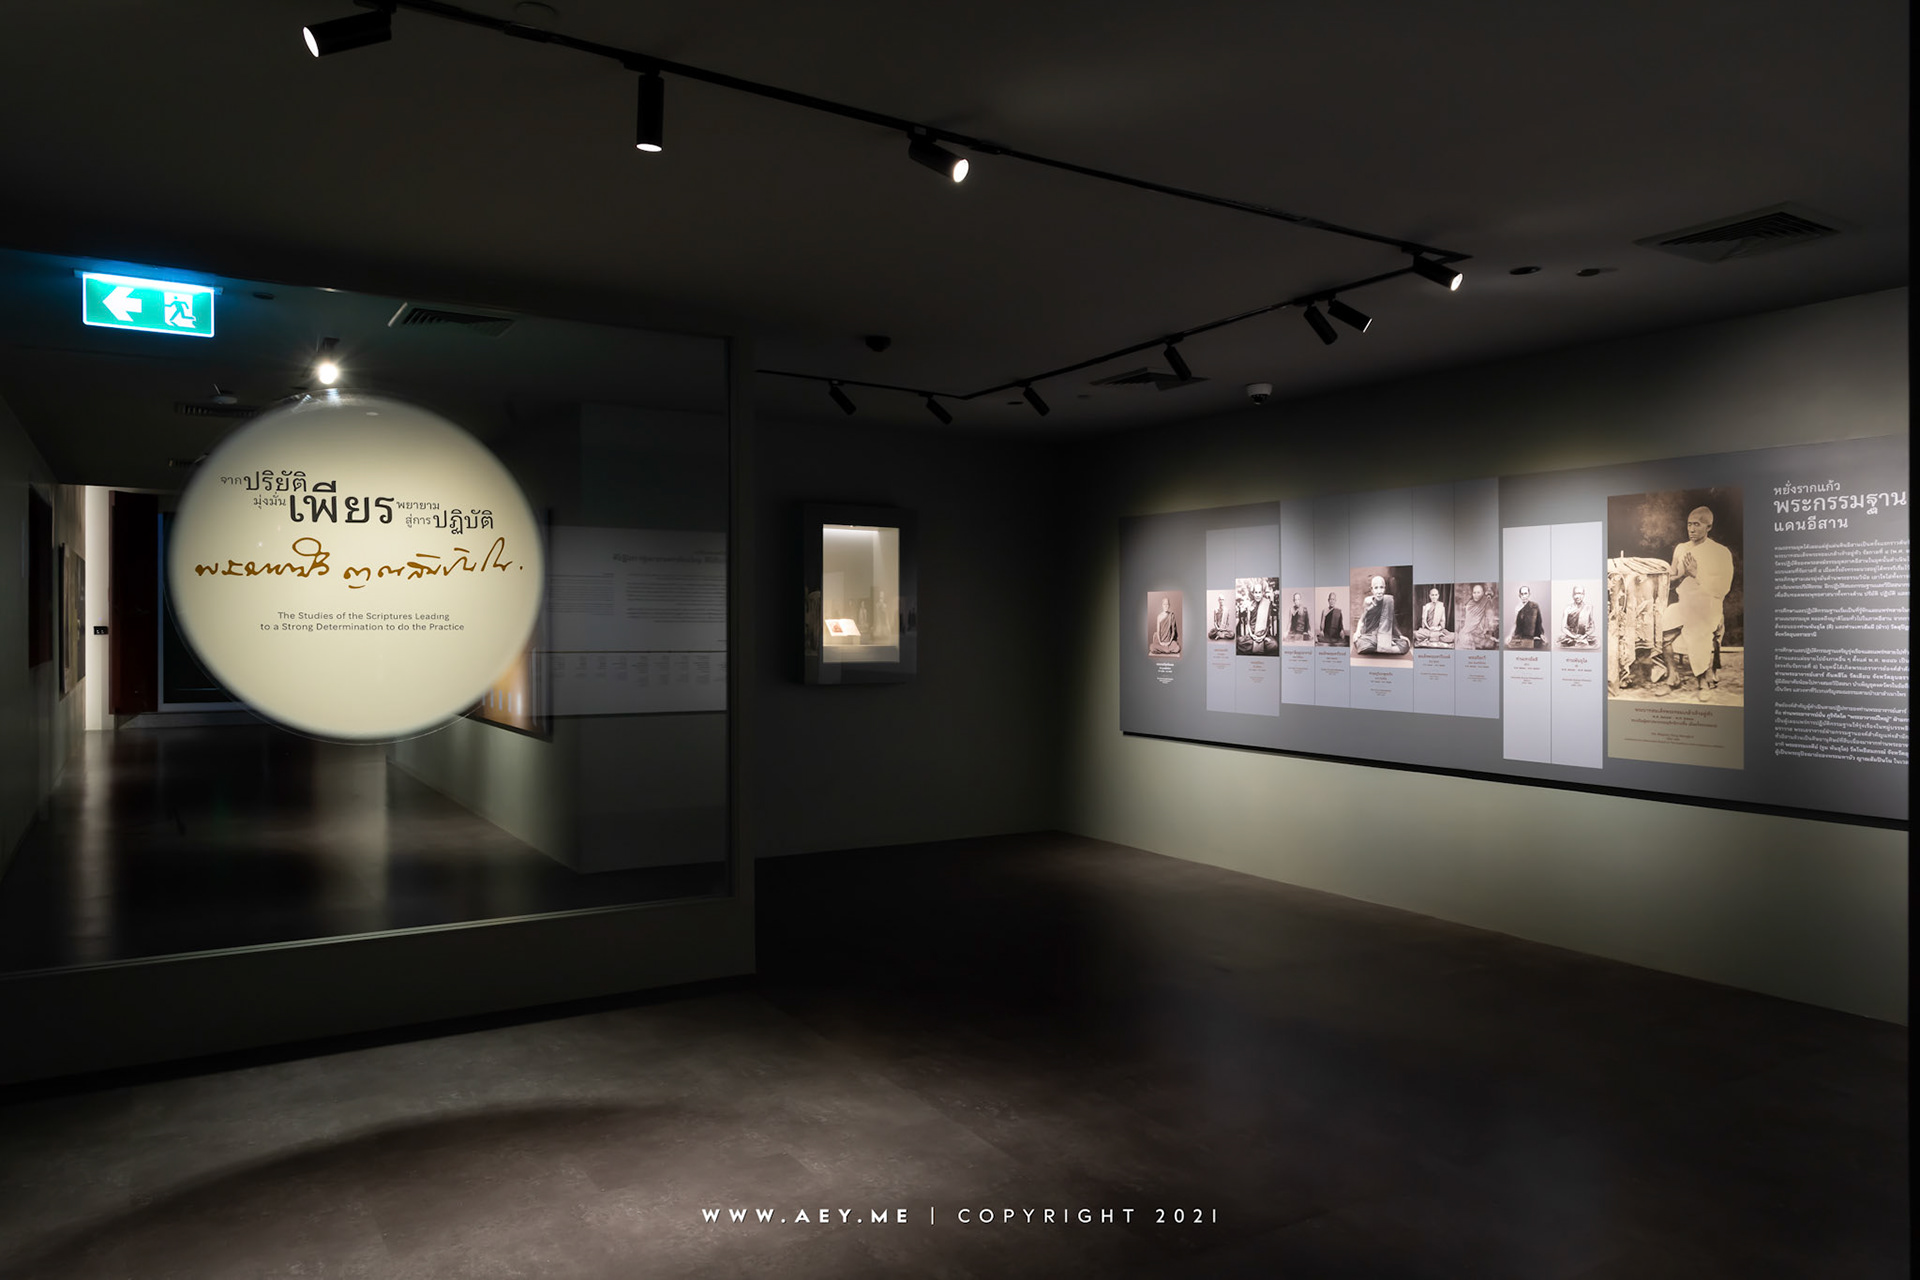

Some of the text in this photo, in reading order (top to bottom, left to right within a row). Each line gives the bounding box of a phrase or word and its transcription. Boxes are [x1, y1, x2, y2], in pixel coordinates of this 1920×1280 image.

[243, 469, 307, 492] ปริยัติ
[1773, 480, 1841, 495] หยั่งรากแก้ว
[289, 480, 395, 524] เพียร
[396, 501, 440, 510] พยายาม
[1773, 491, 1907, 515] พระกรรมฐาน
[432, 509, 494, 535] ปฏิบัติ
[1774, 515, 1849, 532] แดนอีสาน
[278, 612, 449, 621] The Studies of the Scriptures Leading
[260, 623, 270, 631] to
[282, 623, 313, 632] Strong
[316, 623, 382, 631] Determination
[386, 623, 395, 631] to
[398, 623, 409, 631] do
[413, 623, 426, 631] the
[429, 623, 464, 631] Practice
